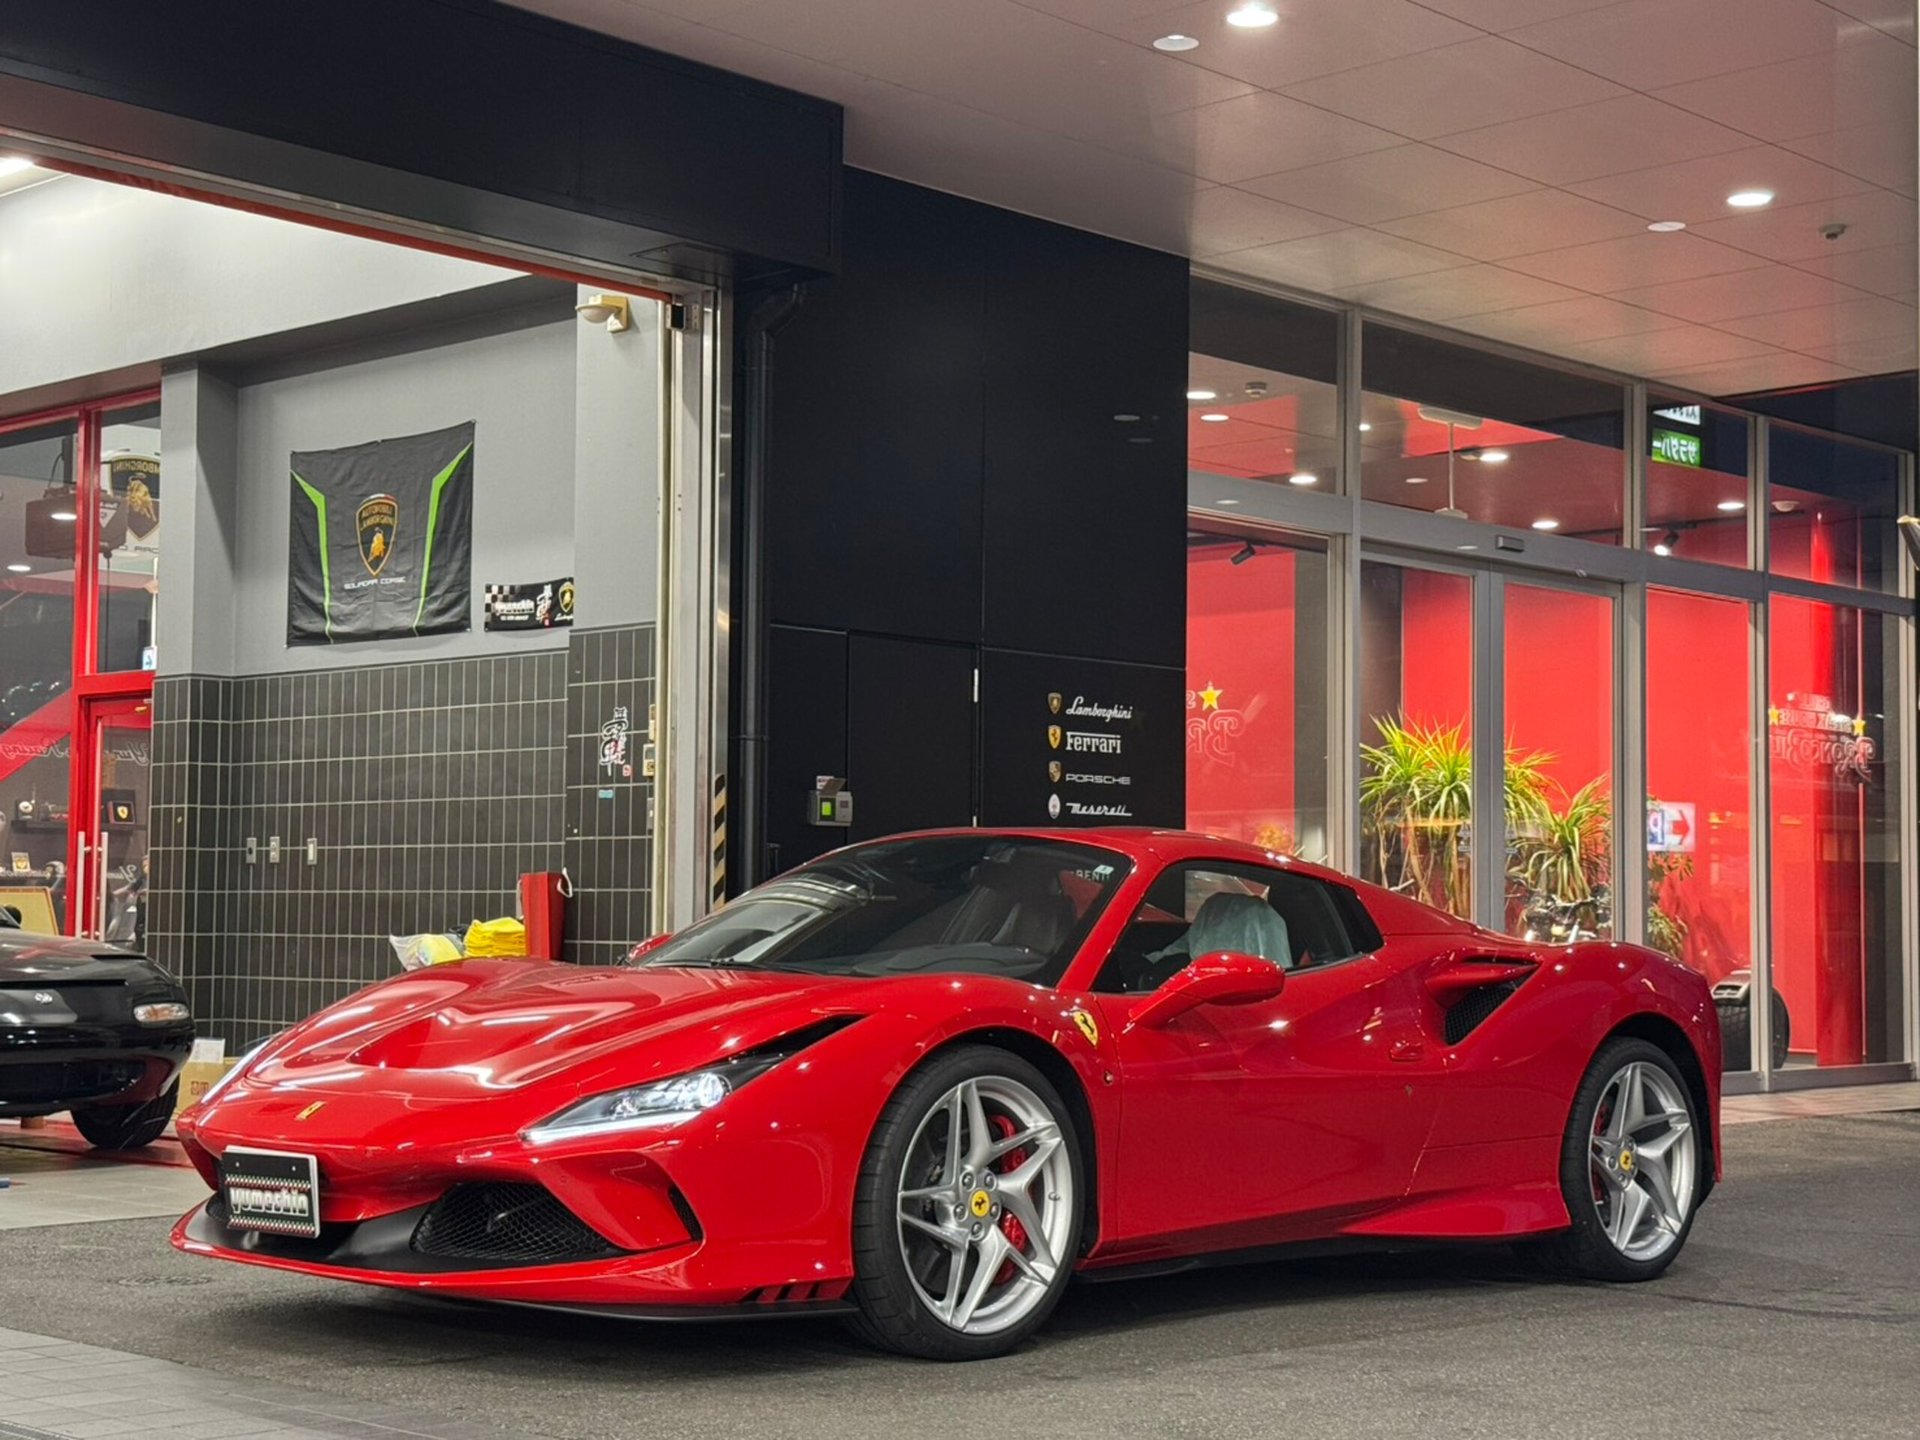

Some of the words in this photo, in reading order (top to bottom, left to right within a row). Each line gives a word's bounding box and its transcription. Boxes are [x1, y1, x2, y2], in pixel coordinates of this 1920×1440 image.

[1065, 696, 1133, 722] Lamborghini
[1065, 731, 1122, 754] Ferrari
[1065, 773, 1131, 785] PORSCHE
[1065, 802, 1133, 817] Maserati
